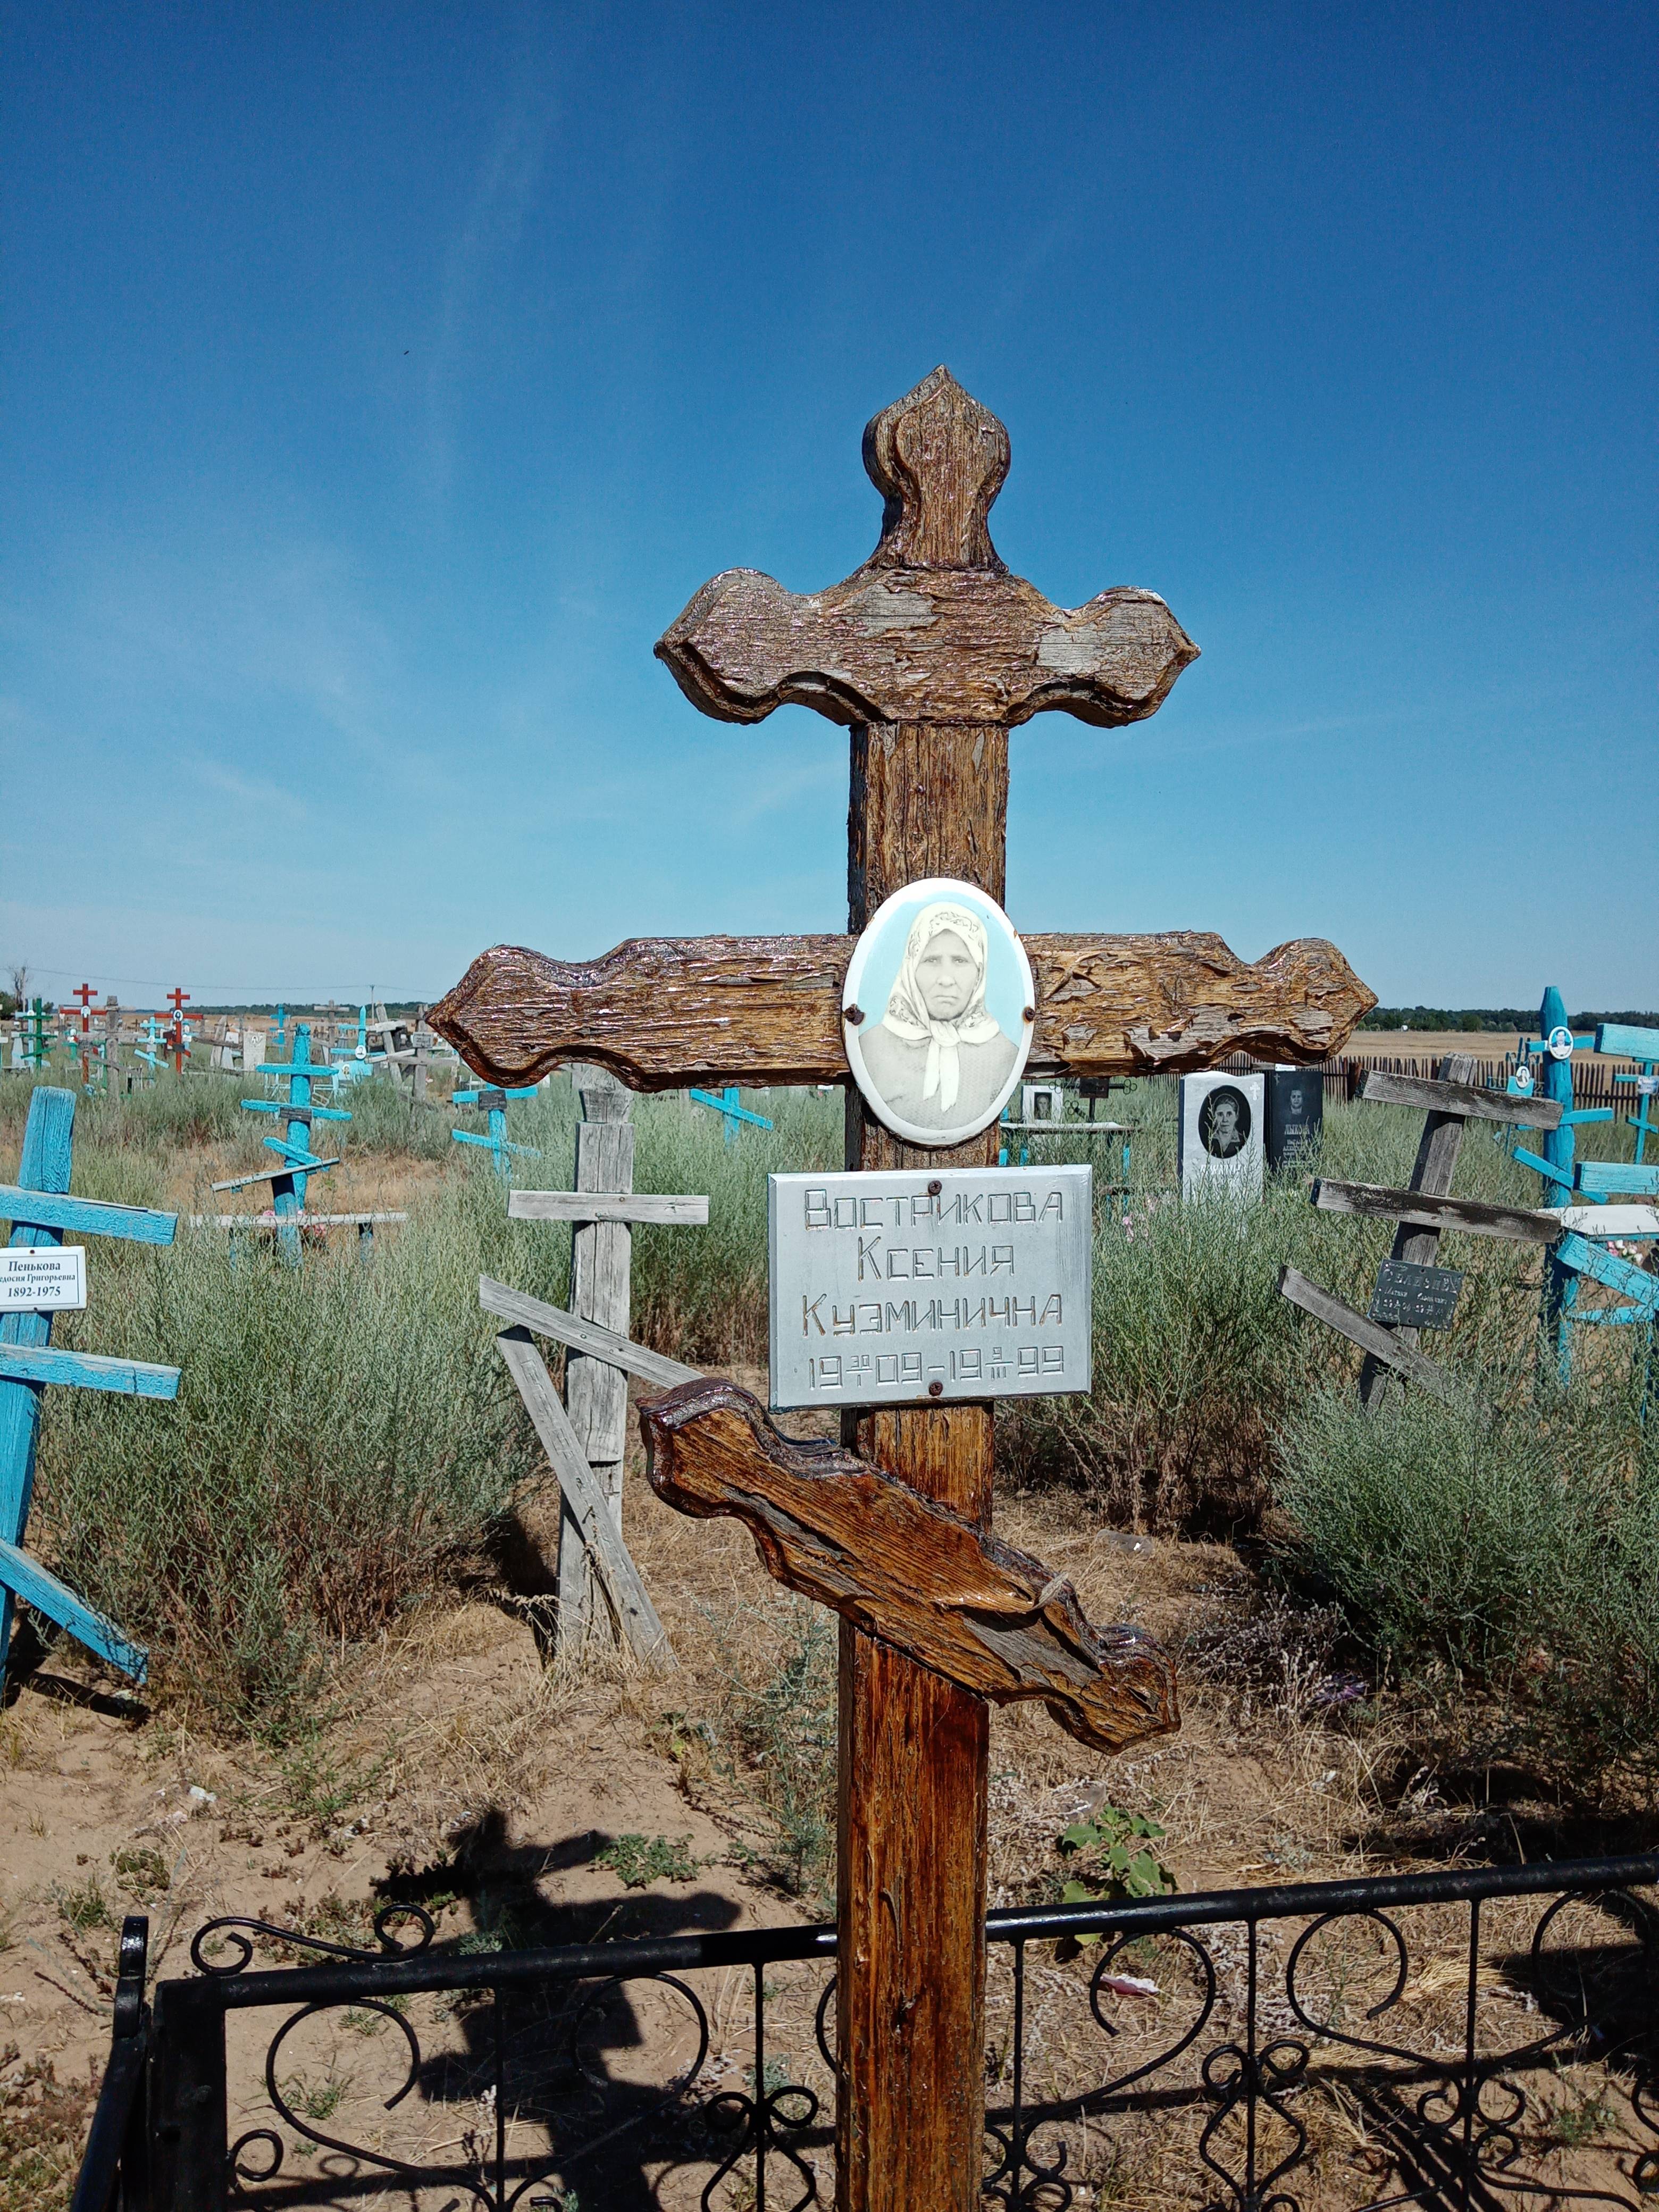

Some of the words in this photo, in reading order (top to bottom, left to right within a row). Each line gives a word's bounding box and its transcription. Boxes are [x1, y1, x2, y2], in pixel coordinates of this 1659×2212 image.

[805, 1189, 1063, 1230] ВОСТРИКОВА
[857, 1236, 1015, 1281] КСЕНИЯ
[9, 1261, 61, 1271] Пенькова
[27, 1273, 76, 1284] Григорьевна
[8, 1286, 61, 1297] 1892-1975
